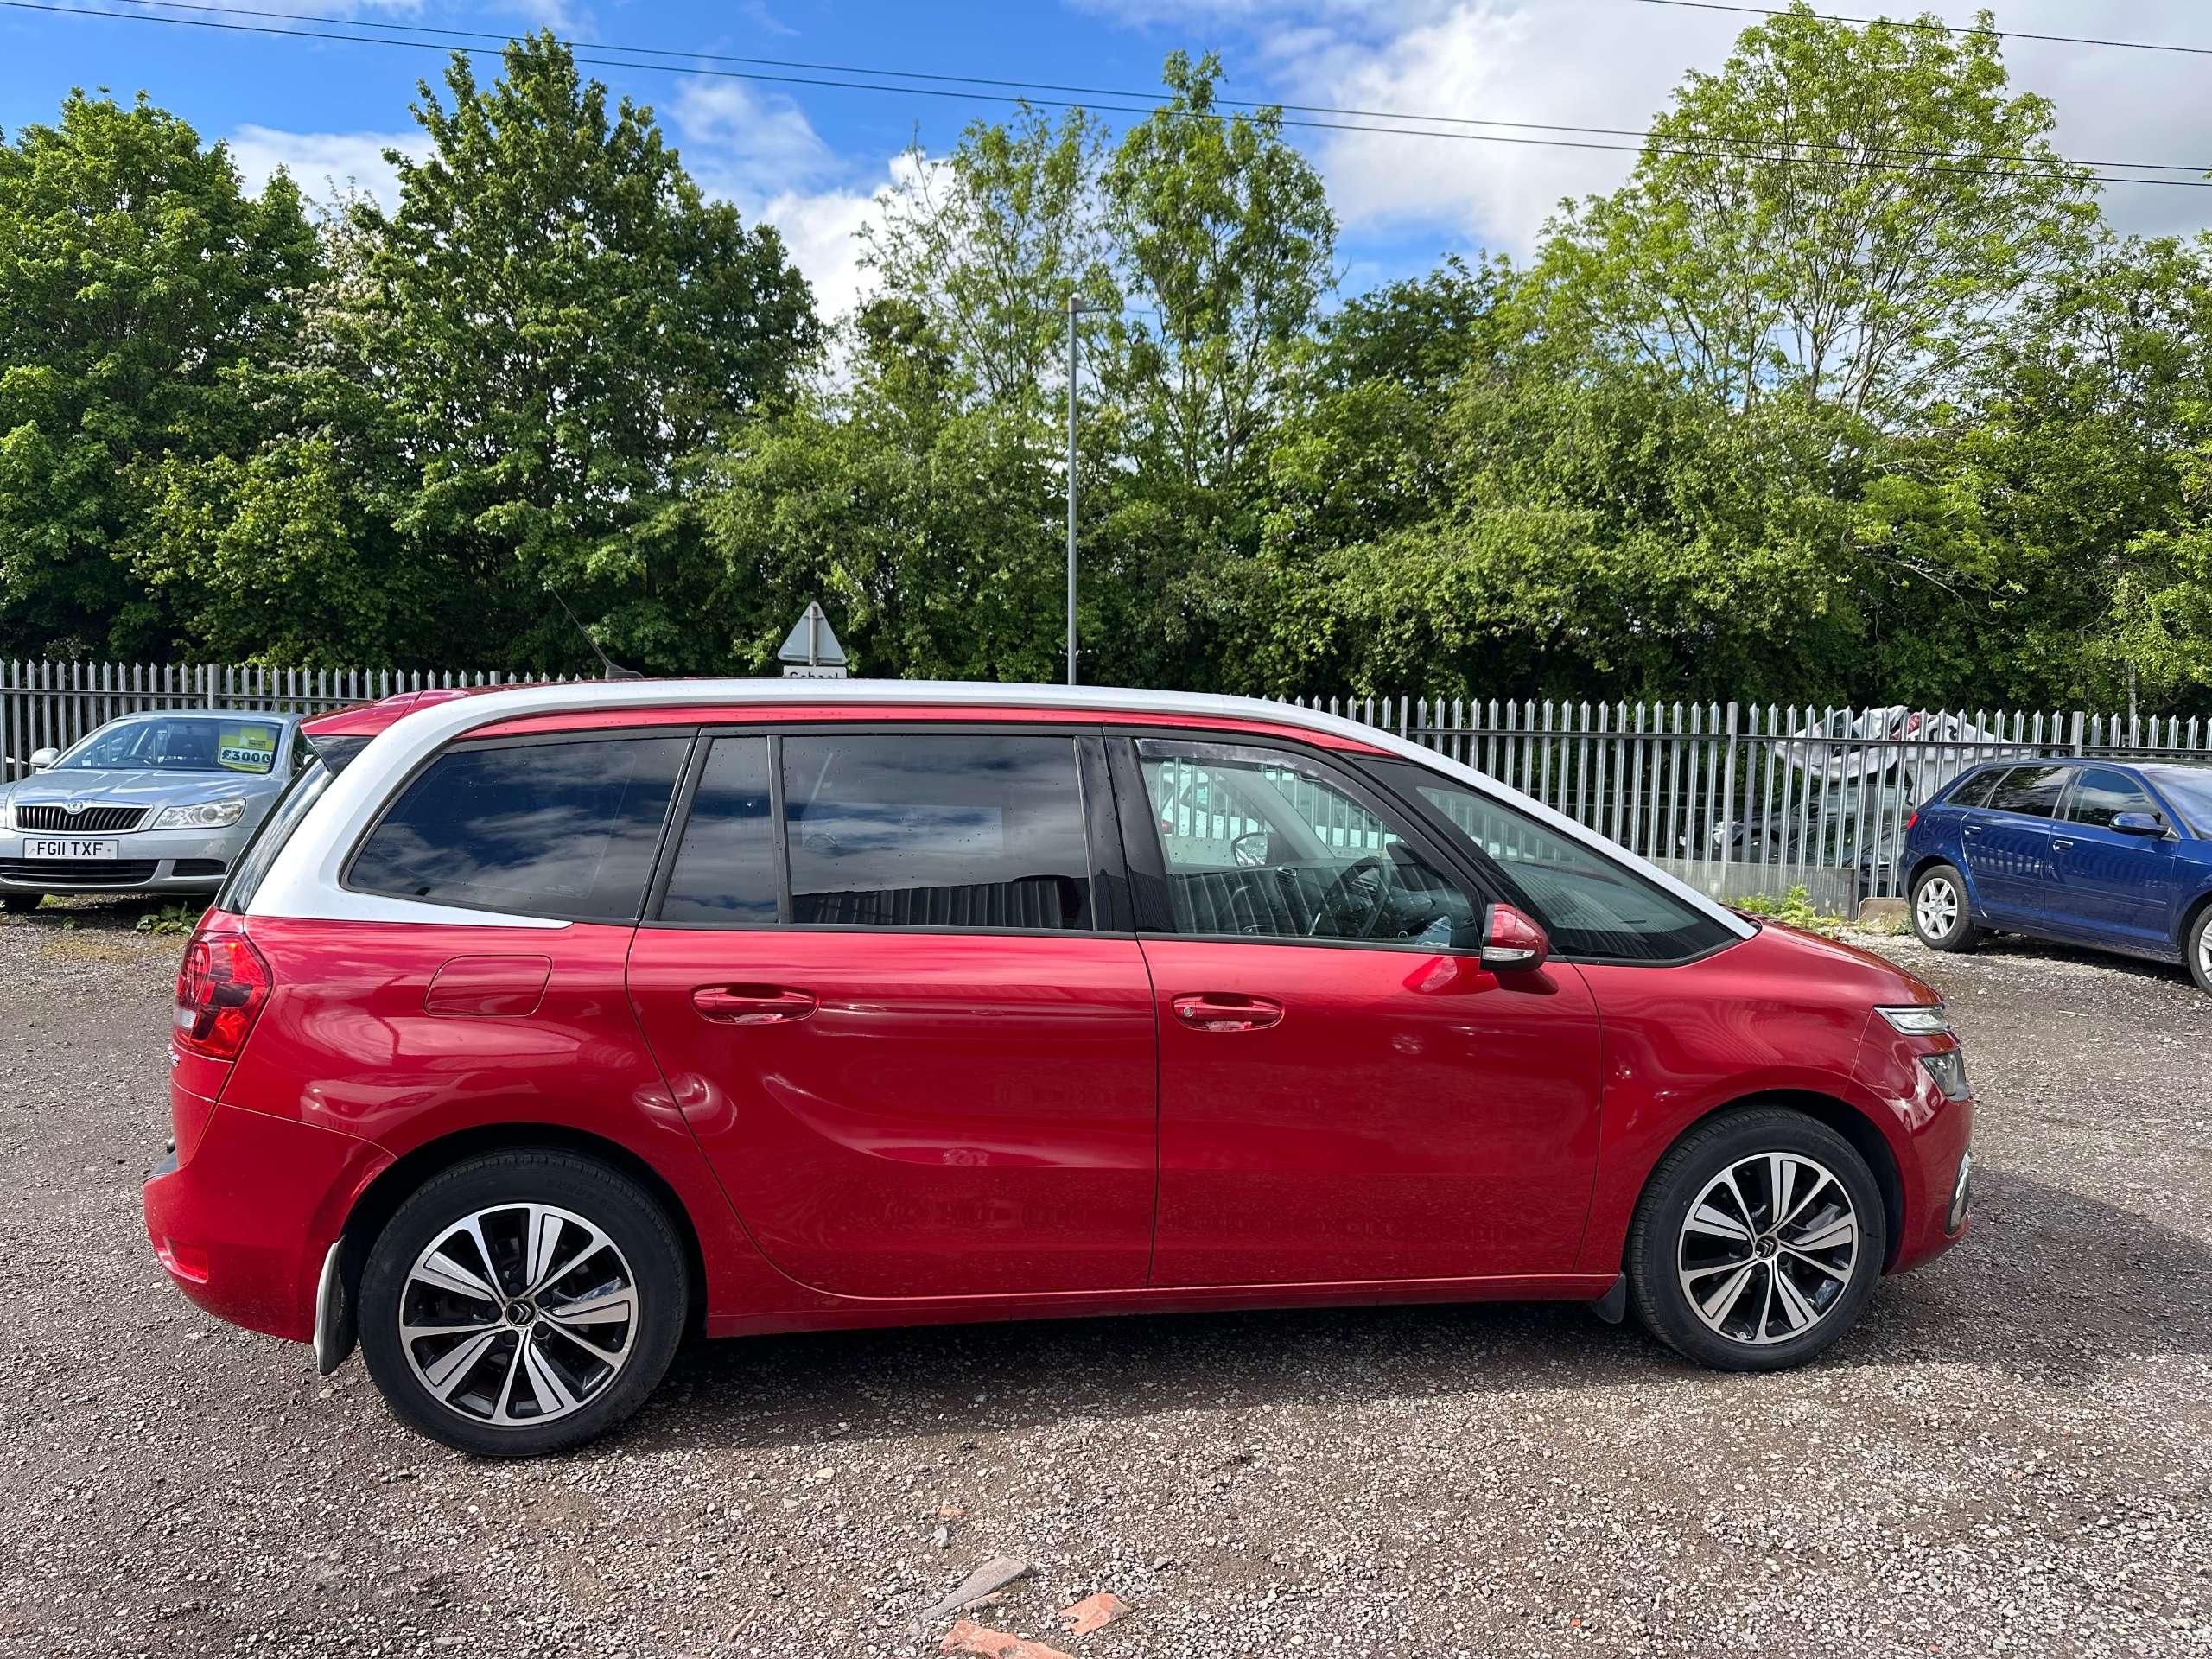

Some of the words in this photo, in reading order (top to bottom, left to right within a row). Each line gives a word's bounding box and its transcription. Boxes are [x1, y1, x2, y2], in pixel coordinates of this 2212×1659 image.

[221, 749, 270, 764] £3000
[37, 842, 66, 855] FG11
[71, 842, 104, 856] TXF
